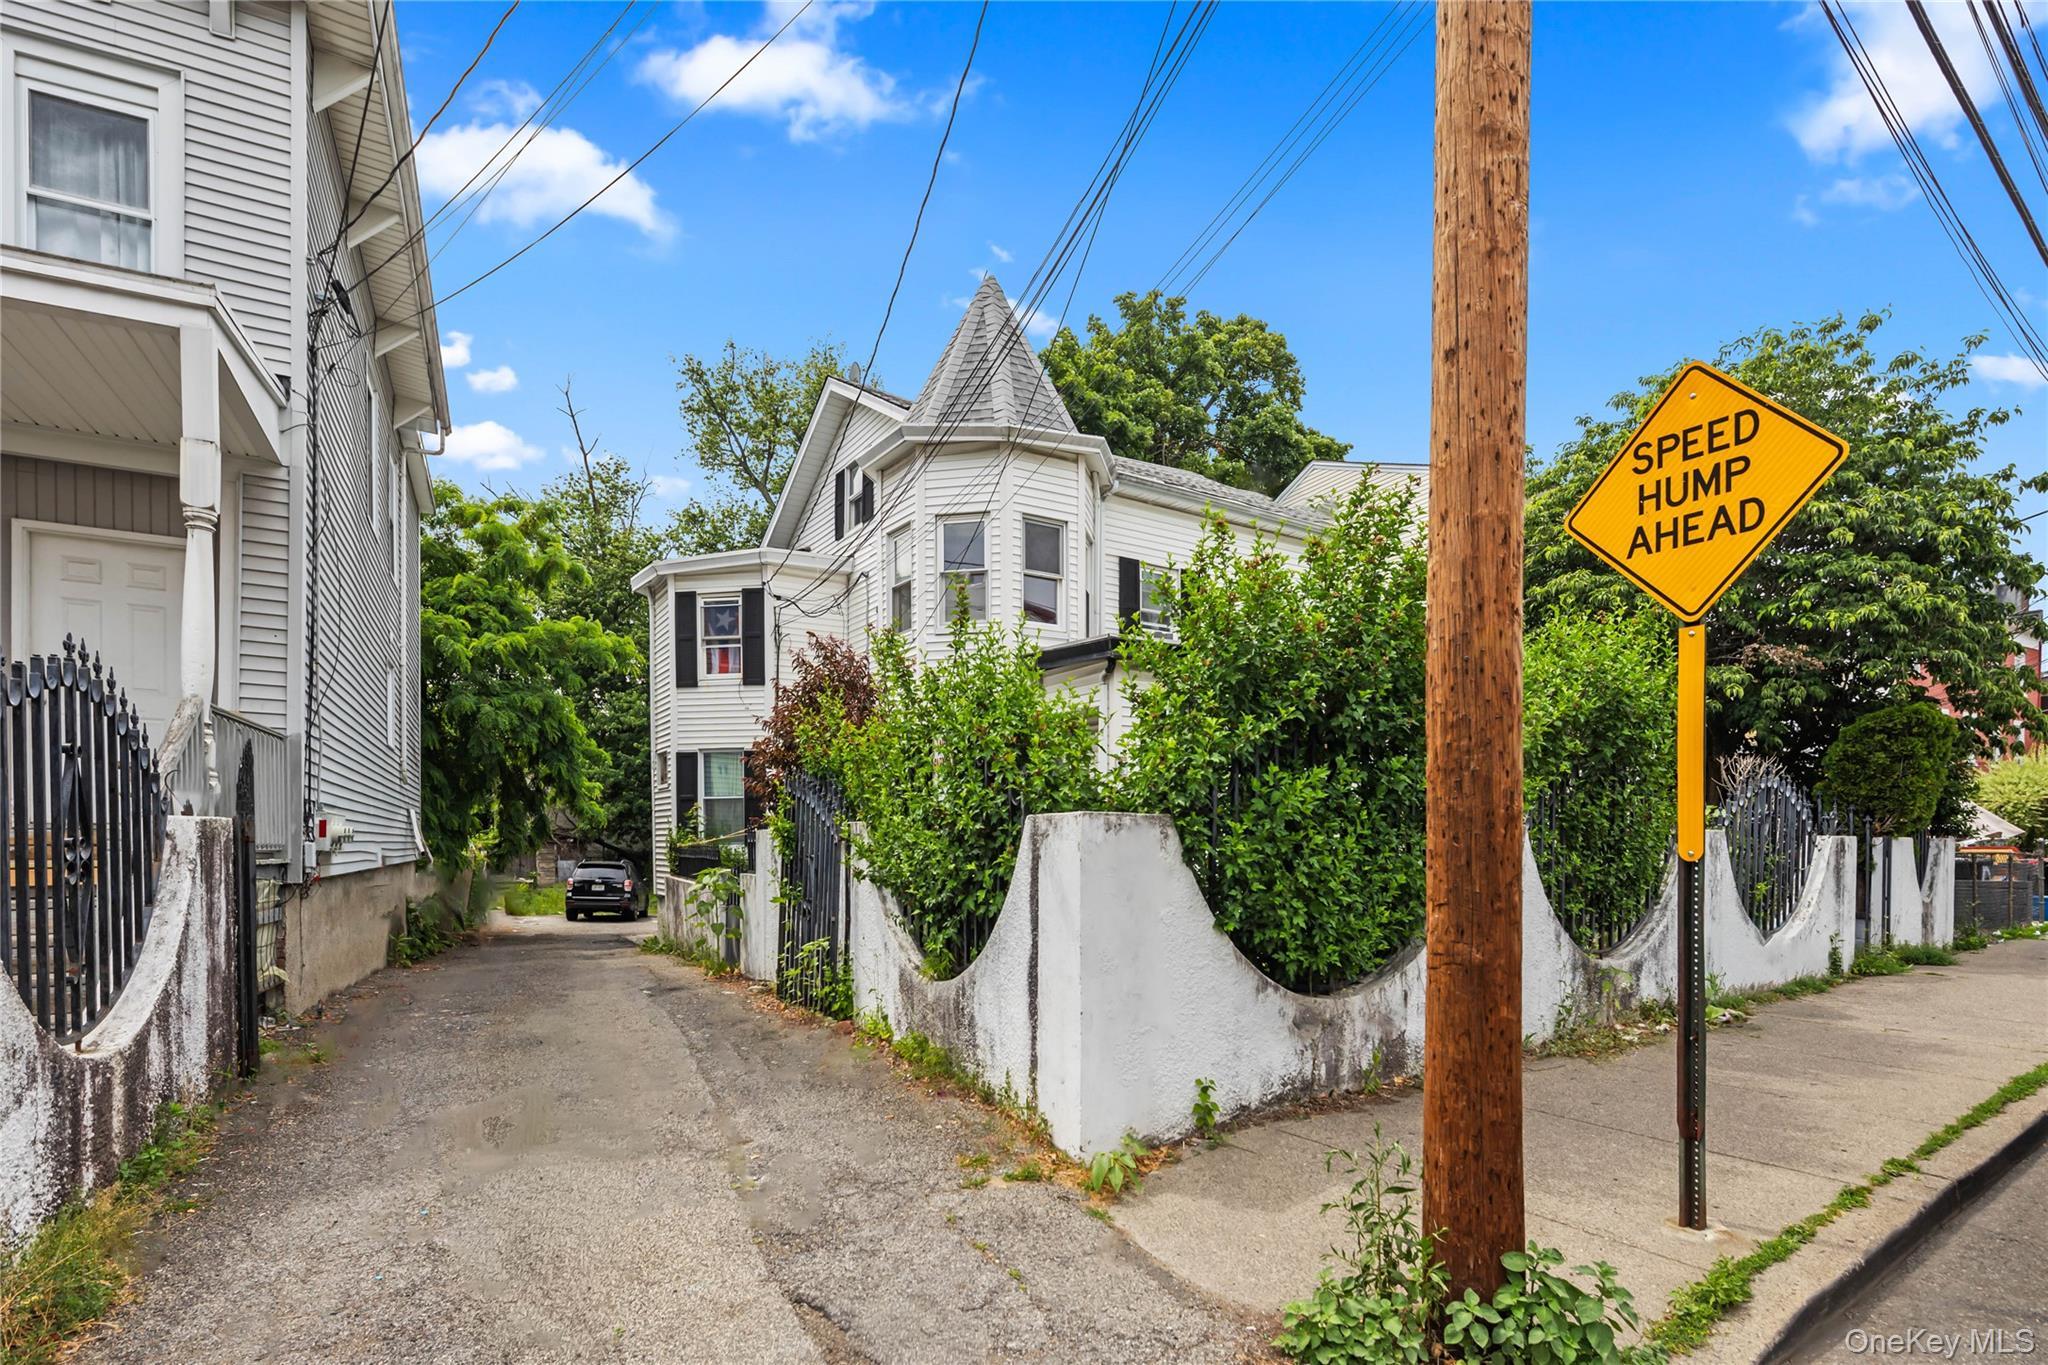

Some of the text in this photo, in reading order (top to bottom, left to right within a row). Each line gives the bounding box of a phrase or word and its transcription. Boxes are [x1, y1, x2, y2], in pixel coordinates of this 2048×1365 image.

[1632, 409, 1760, 475] SPEED
[1638, 455, 1751, 516] HUMP
[1626, 497, 1765, 560] AHEAD
